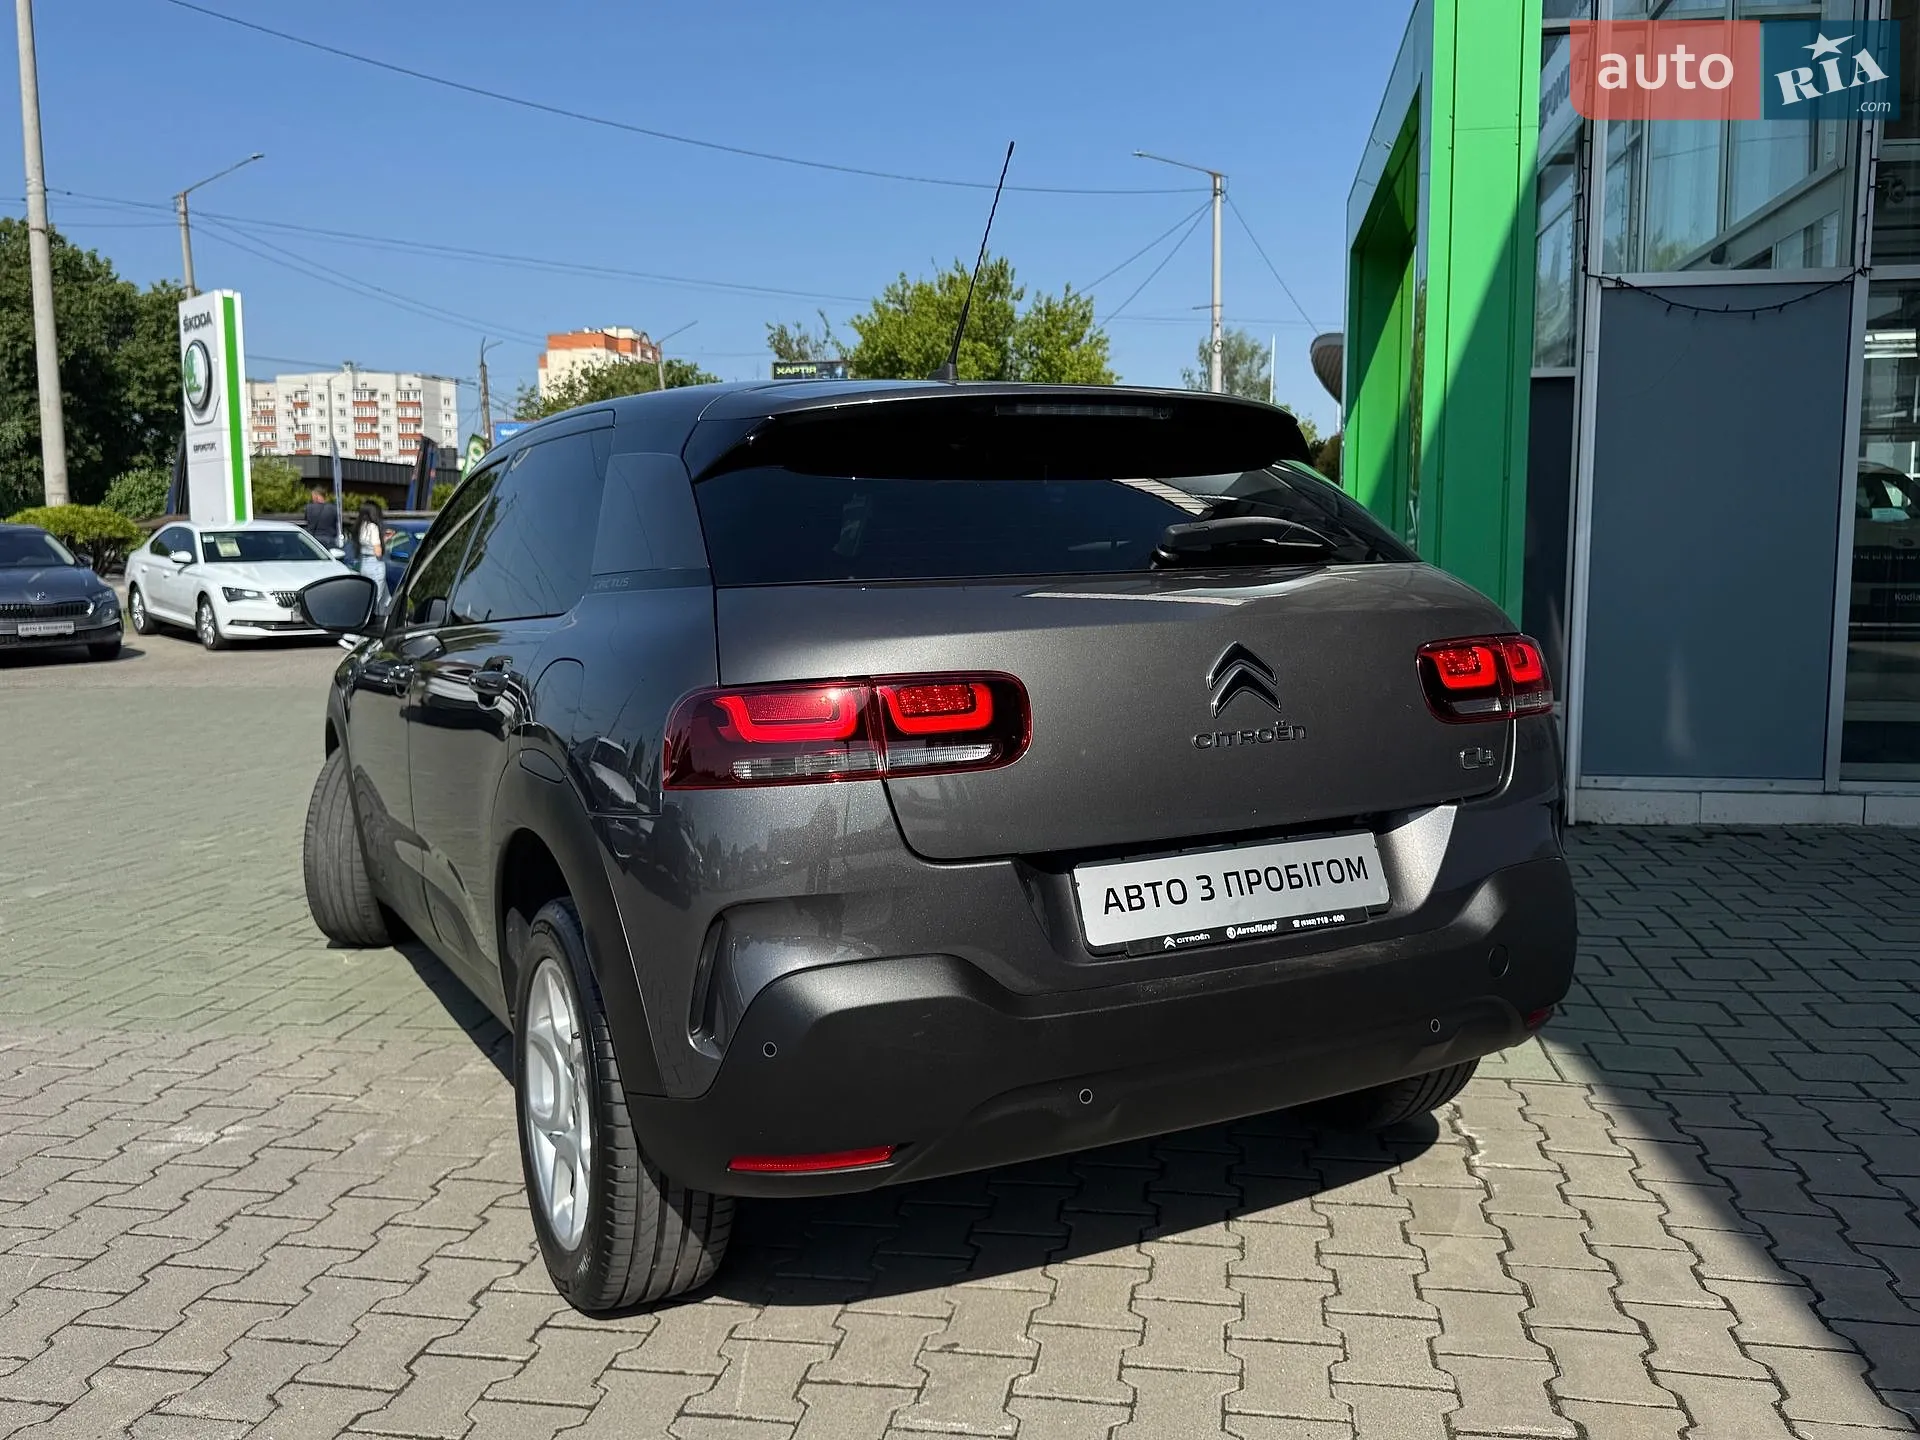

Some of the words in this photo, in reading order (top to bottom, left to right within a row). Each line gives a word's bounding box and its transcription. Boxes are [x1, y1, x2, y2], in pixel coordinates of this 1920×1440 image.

[1459, 747, 1495, 769] C4
[1103, 878, 1188, 915] АВТО
[1223, 856, 1369, 897] ПРОБІГОМ
